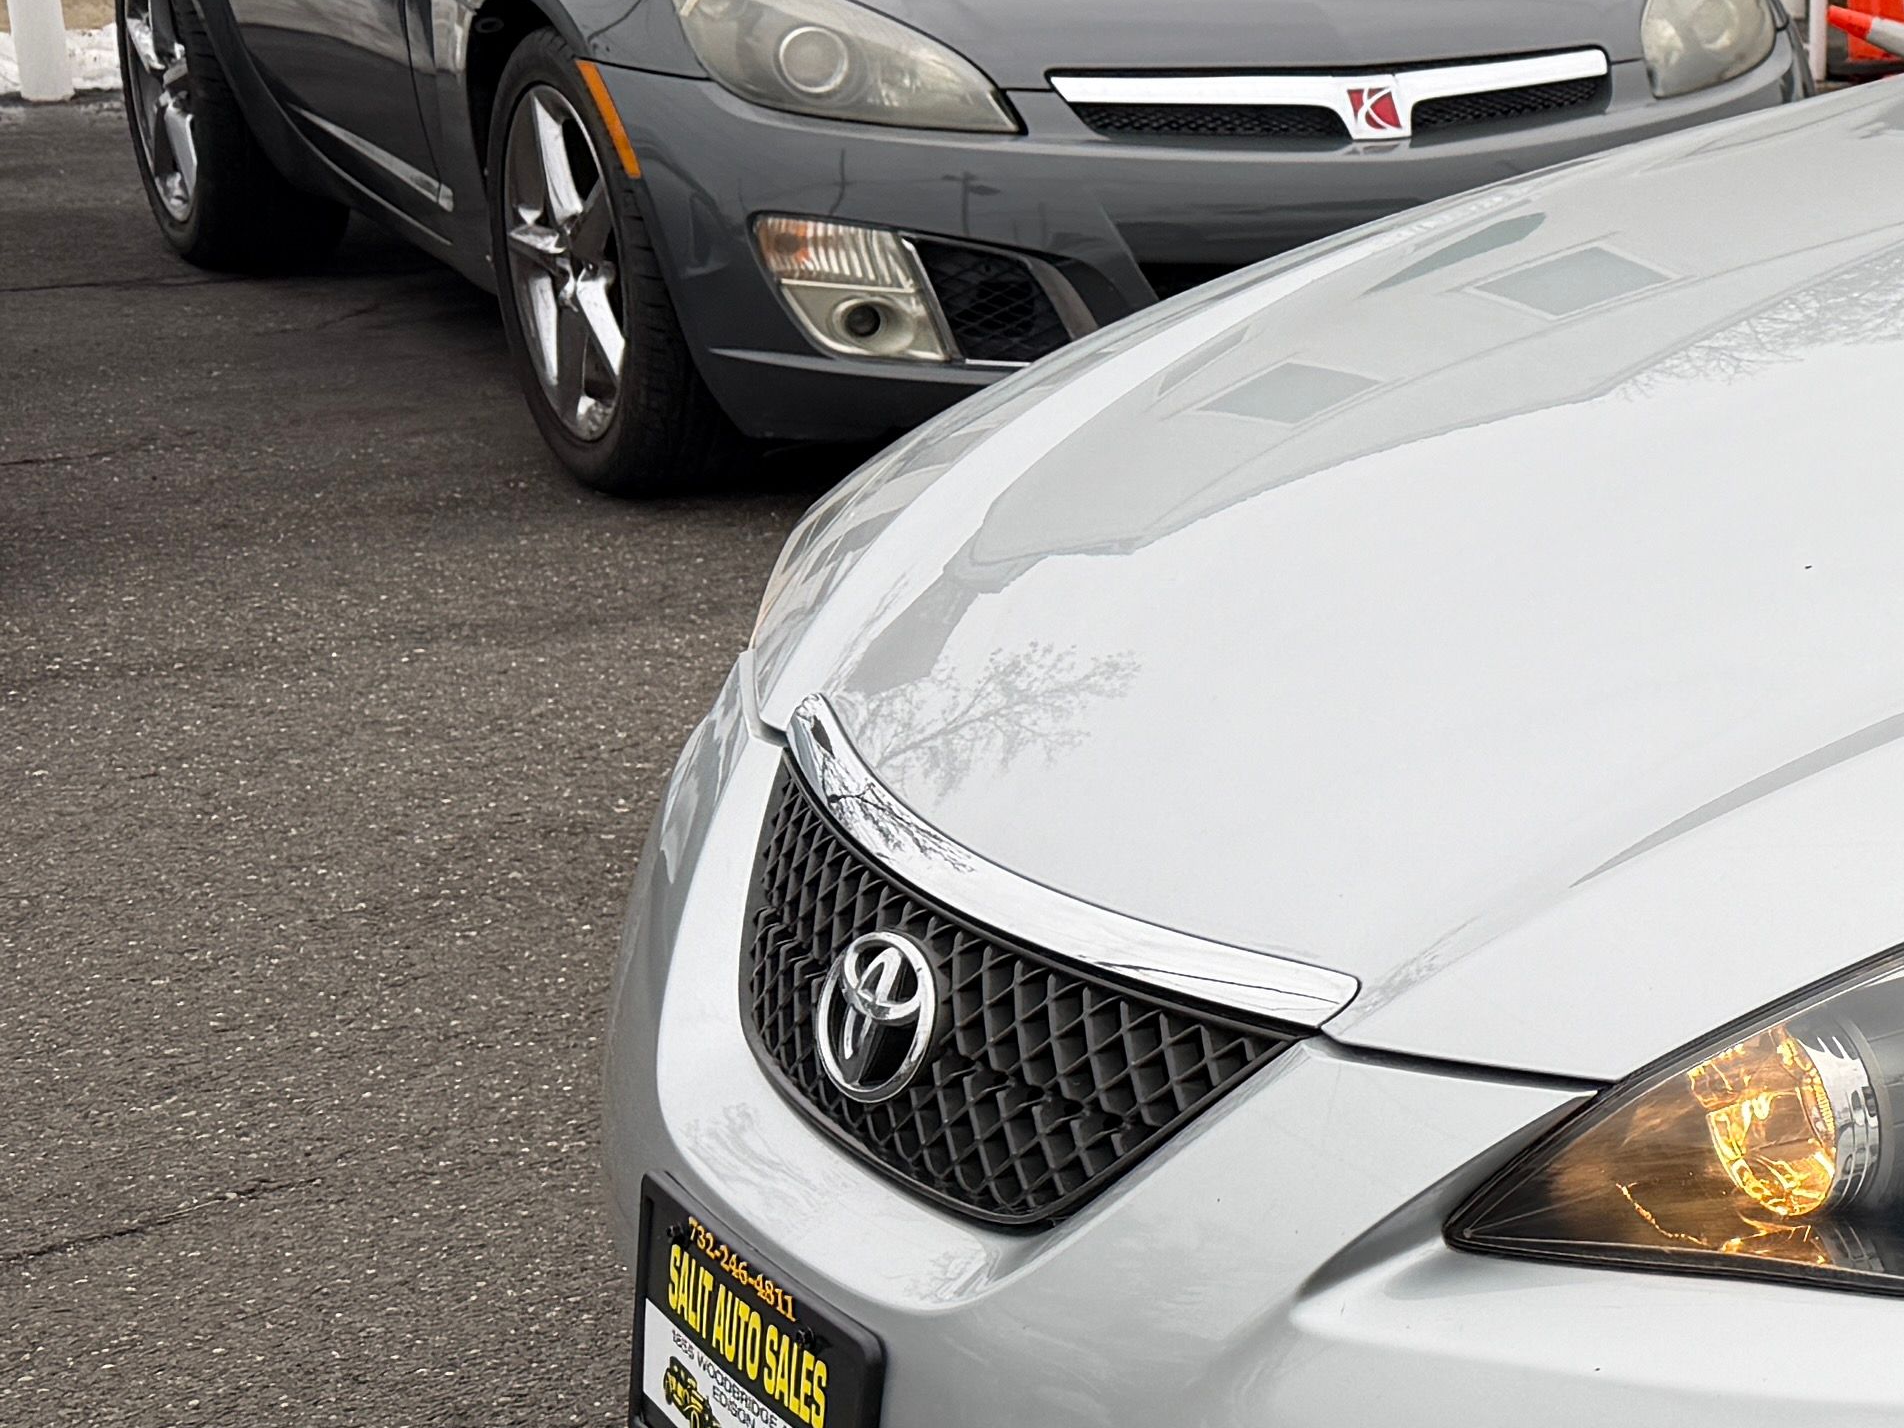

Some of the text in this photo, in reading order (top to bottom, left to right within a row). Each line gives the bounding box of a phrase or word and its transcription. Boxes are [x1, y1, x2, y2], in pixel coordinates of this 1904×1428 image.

[668, 1243, 714, 1339] SALIT
[711, 1283, 761, 1380] AUTO
[688, 1215, 797, 1322] 732-246-4811
